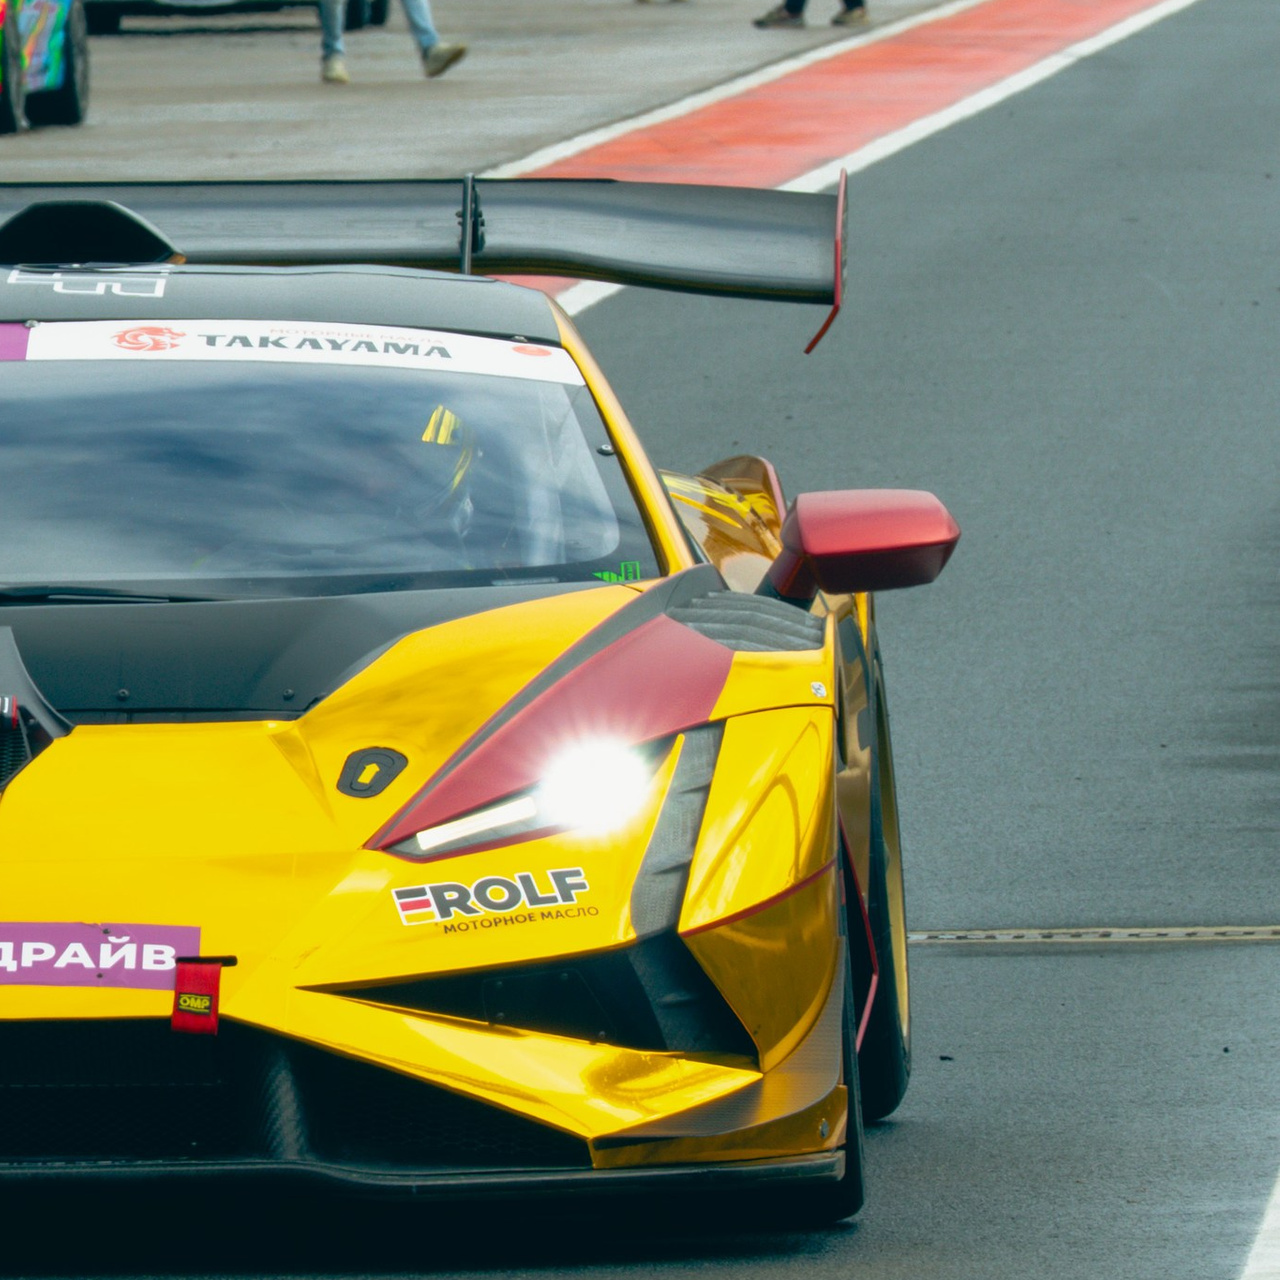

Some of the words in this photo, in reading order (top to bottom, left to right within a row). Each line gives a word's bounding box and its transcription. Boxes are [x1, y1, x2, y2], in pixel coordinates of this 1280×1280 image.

[197, 334, 452, 358] TAKAYAMA
[428, 867, 589, 921] ROLF
[443, 912, 537, 934] МОТОРНОЕ
[540, 906, 600, 921] МАСЛО
[179, 996, 210, 1009] OMP
